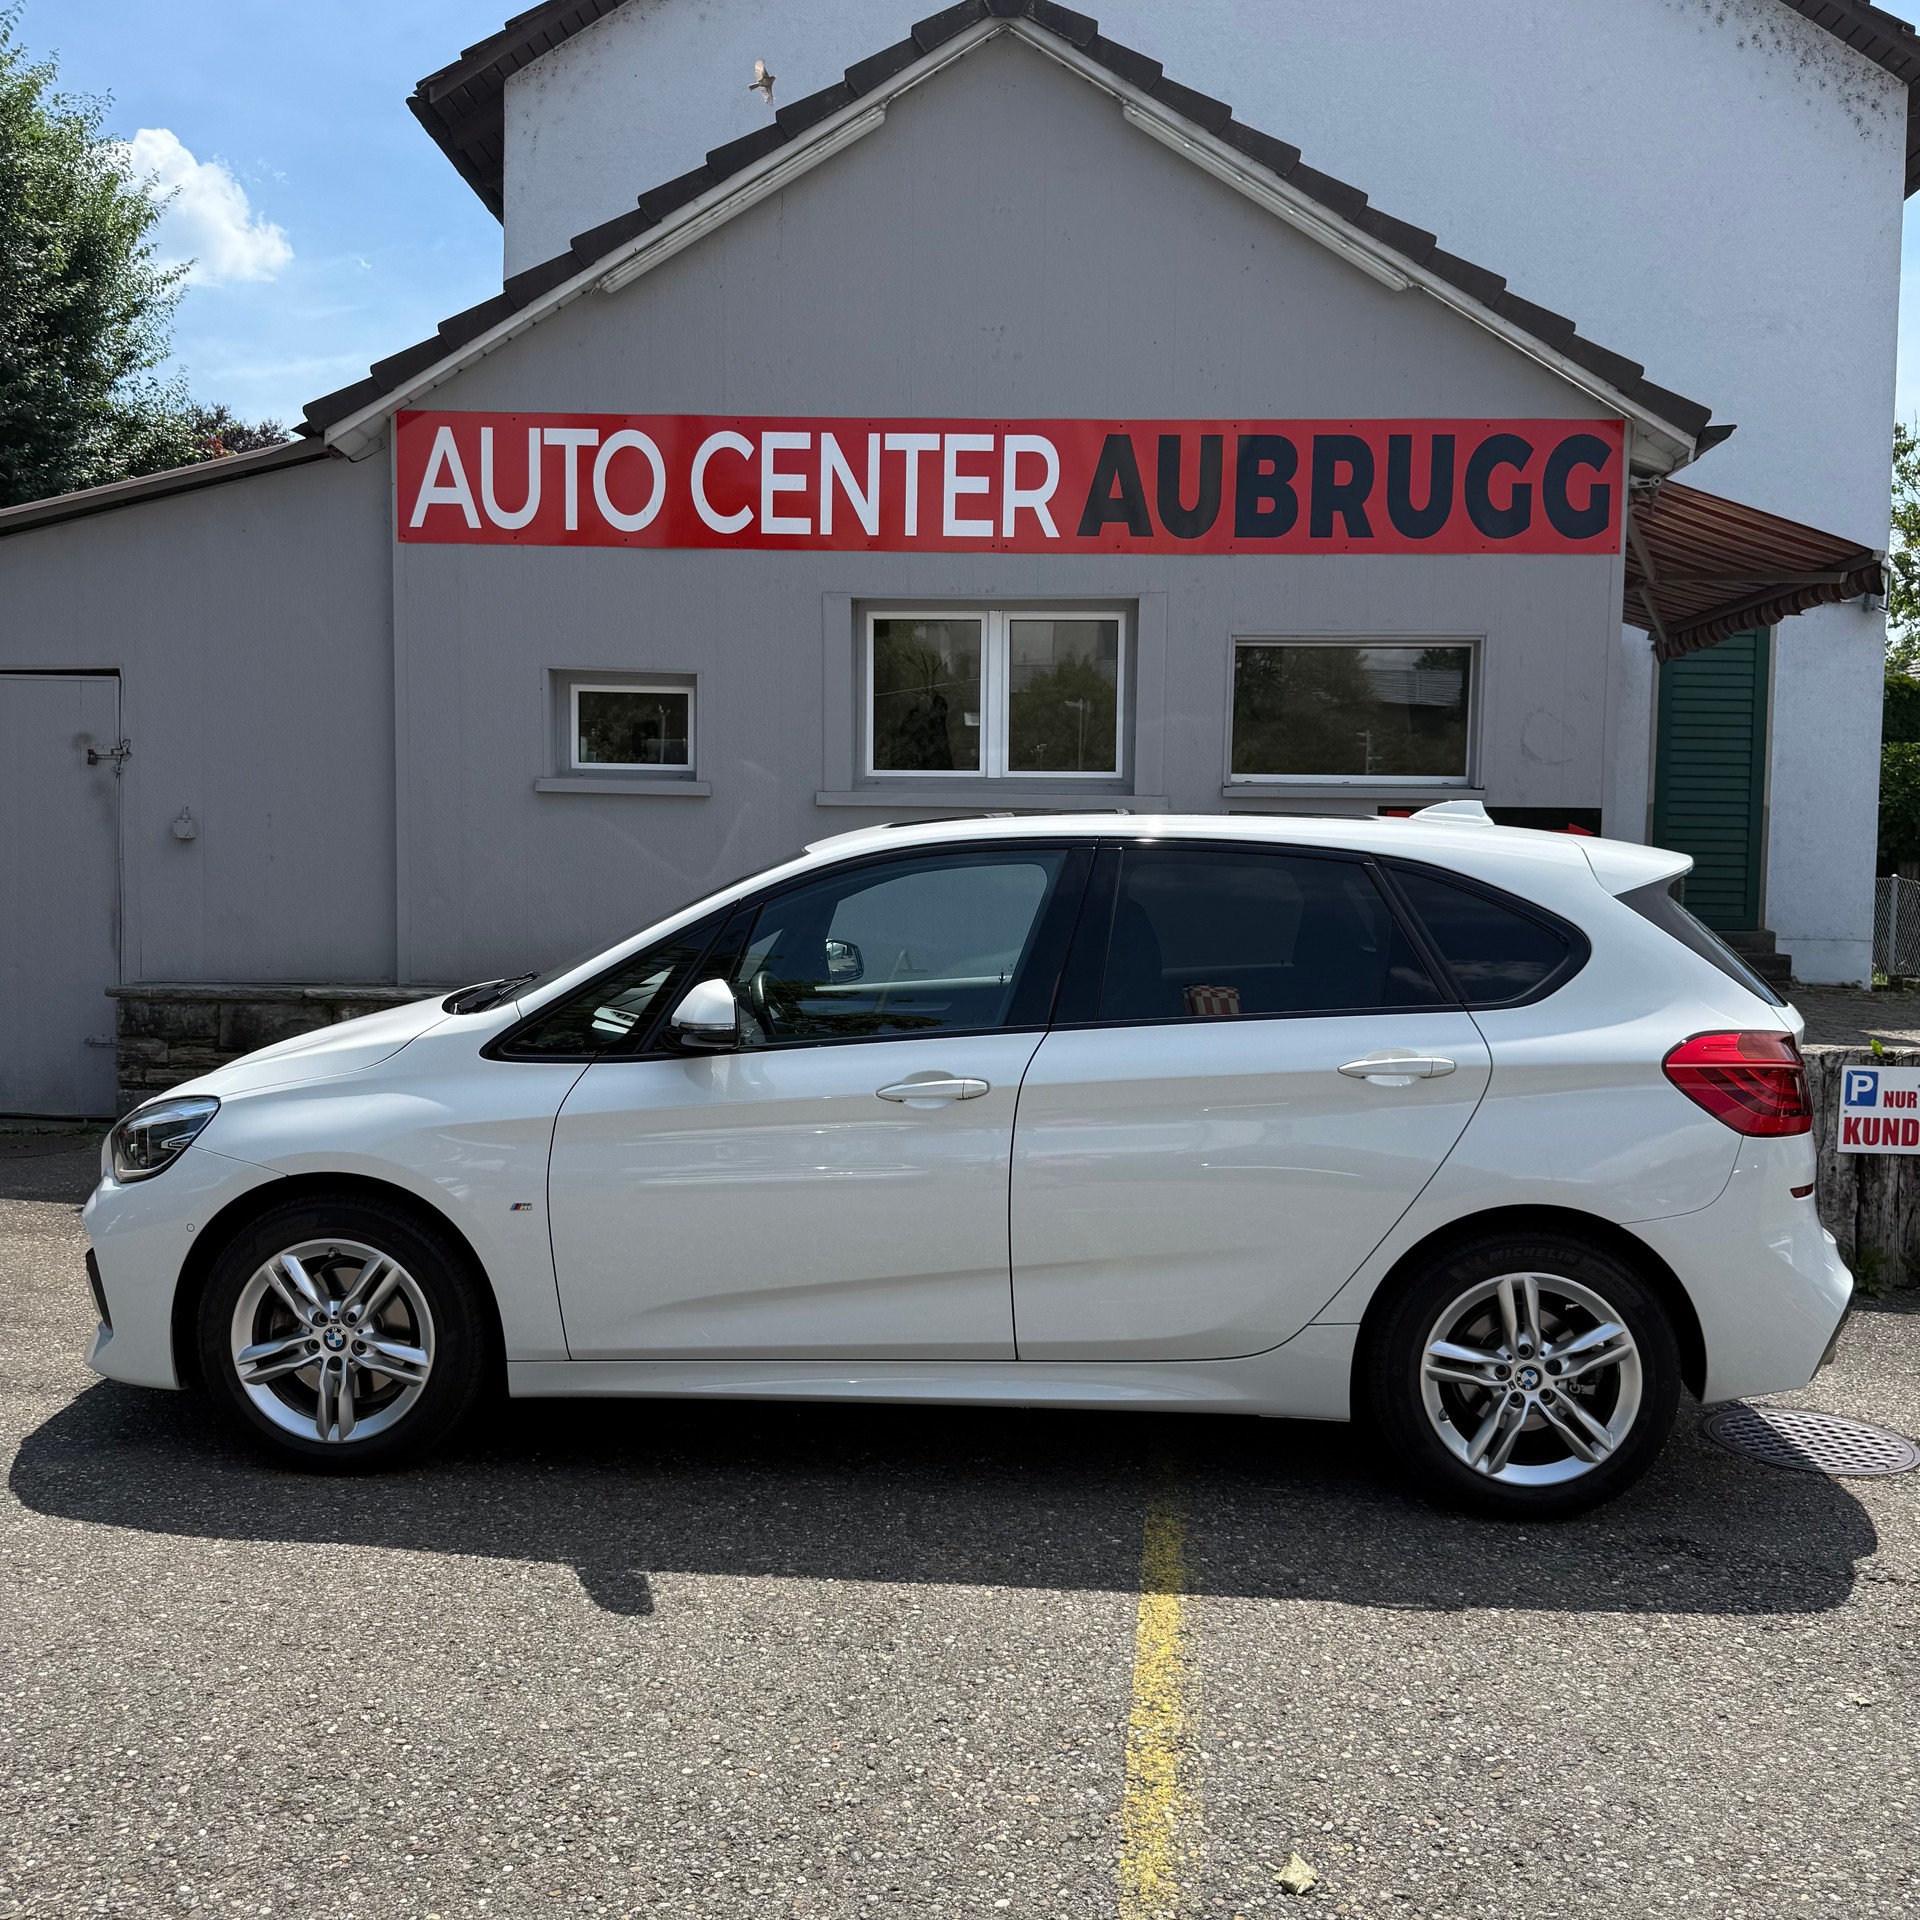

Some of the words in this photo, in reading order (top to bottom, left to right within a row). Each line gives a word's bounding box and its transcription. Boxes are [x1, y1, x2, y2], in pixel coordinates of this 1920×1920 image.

[409, 426, 666, 532] AUTO
[690, 431, 1060, 538] CENTER
[1076, 433, 1613, 540] AUBRUGG
[1850, 1074, 1874, 1102] P
[1883, 1090, 1918, 1109] NUR
[1842, 1116, 1920, 1147] KUND
